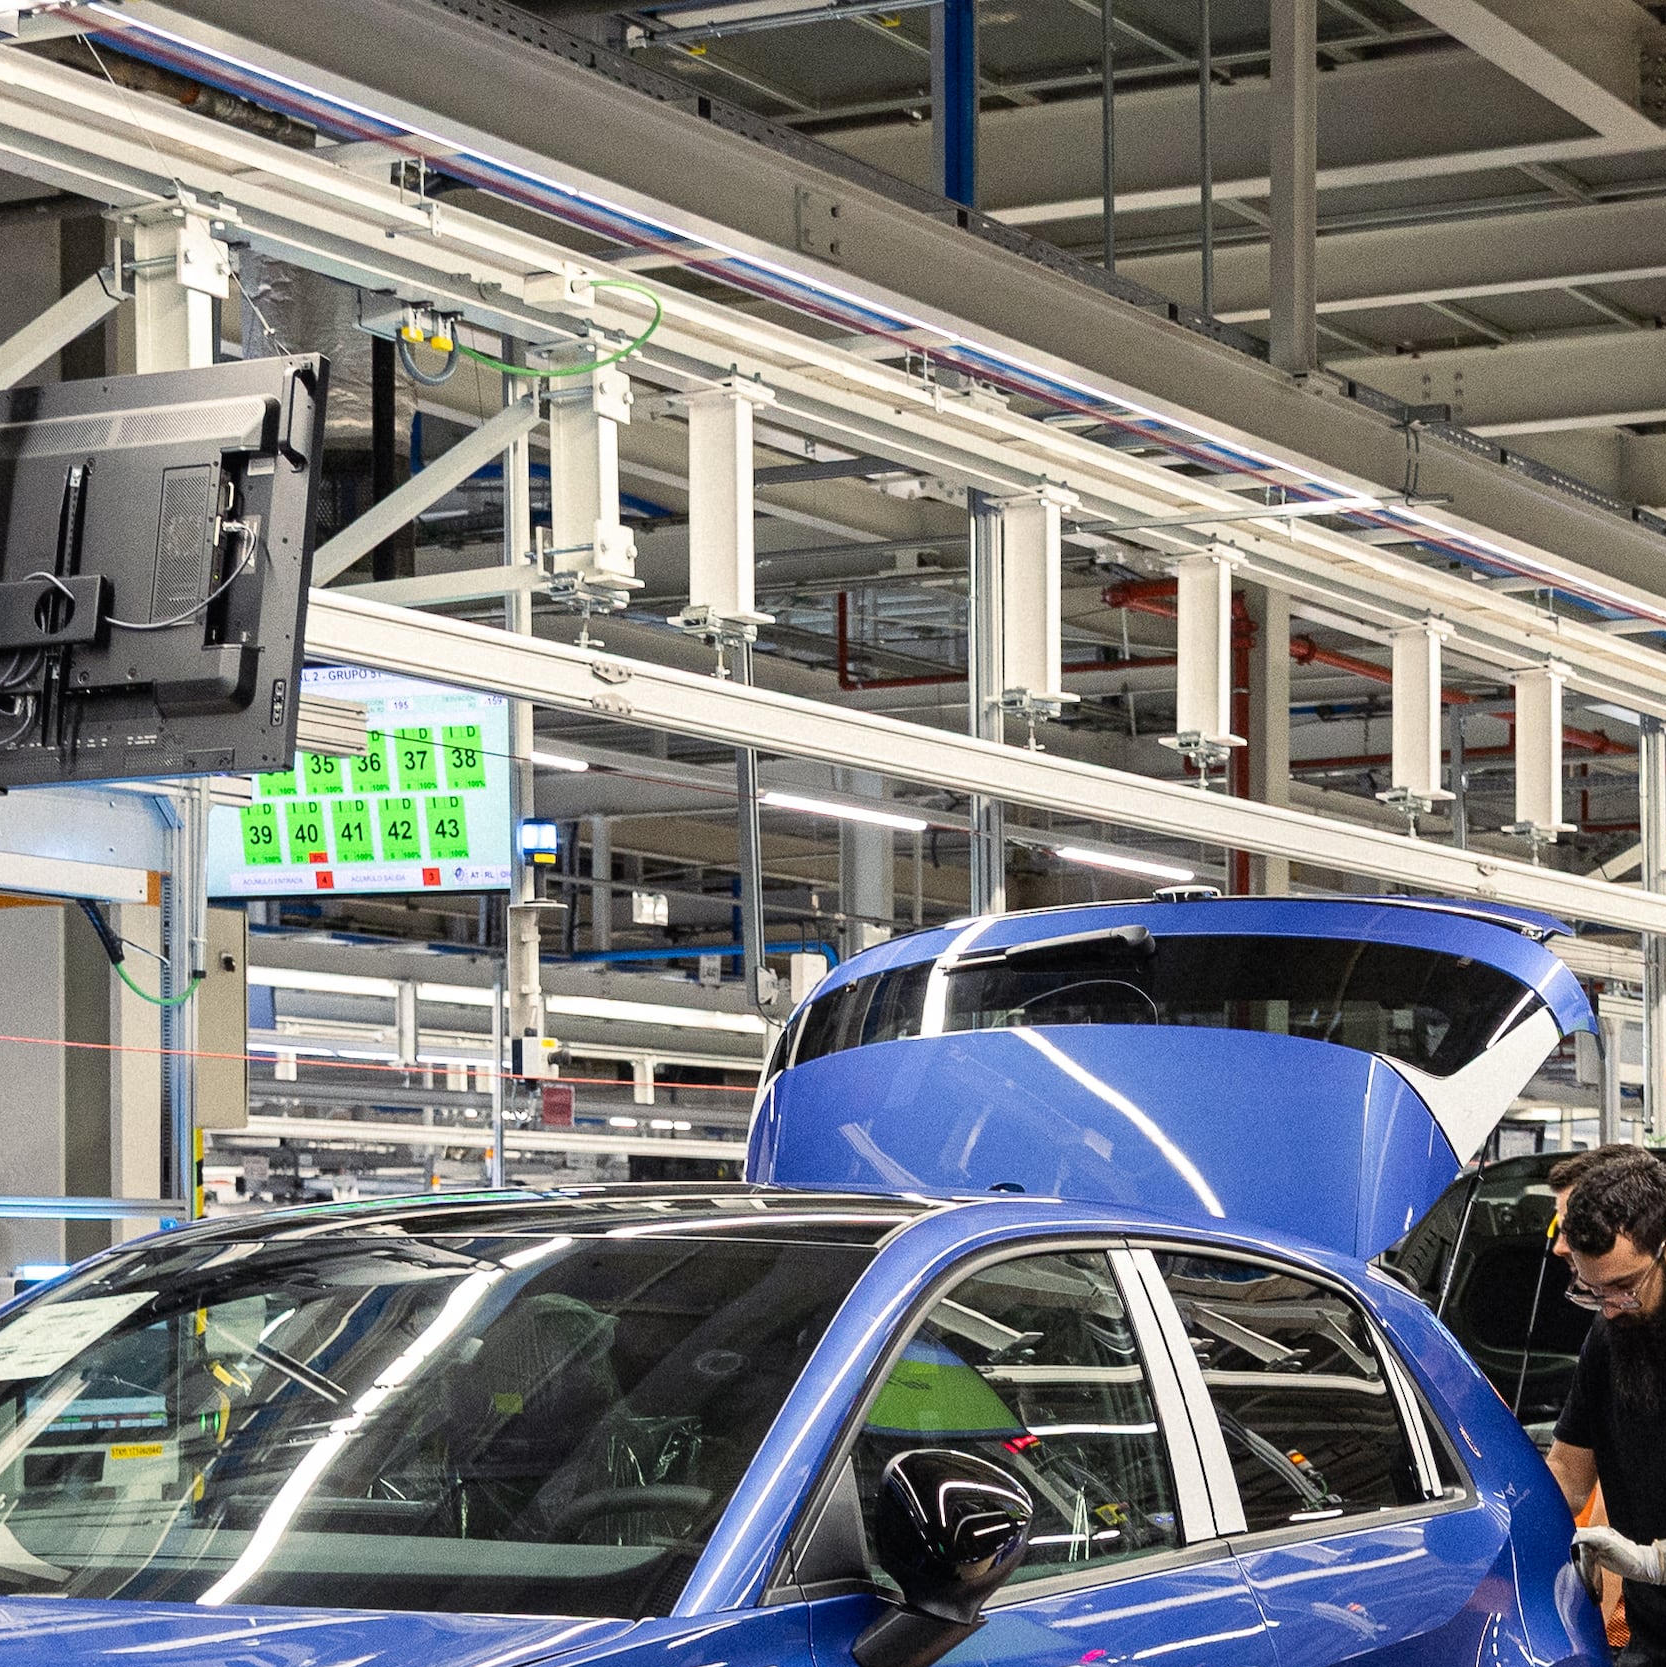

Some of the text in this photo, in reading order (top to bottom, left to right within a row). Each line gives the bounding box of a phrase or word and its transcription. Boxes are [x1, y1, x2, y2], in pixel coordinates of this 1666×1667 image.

[328, 669, 367, 680] GRUPO
[394, 700, 409, 710] 195
[418, 727, 428, 739] D
[466, 725, 476, 737] D
[311, 755, 334, 774] 35
[358, 753, 381, 772] 36
[404, 751, 428, 770] 37
[452, 748, 476, 768] 38
[263, 803, 272, 815] D
[309, 801, 318, 813] D
[355, 800, 364, 811] D
[402, 798, 411, 809] D
[450, 796, 459, 807] D
[249, 826, 273, 844] 39
[295, 824, 318, 843] 40
[341, 822, 364, 841] 41
[388, 821, 413, 840] 42
[435, 819, 460, 838] 43
